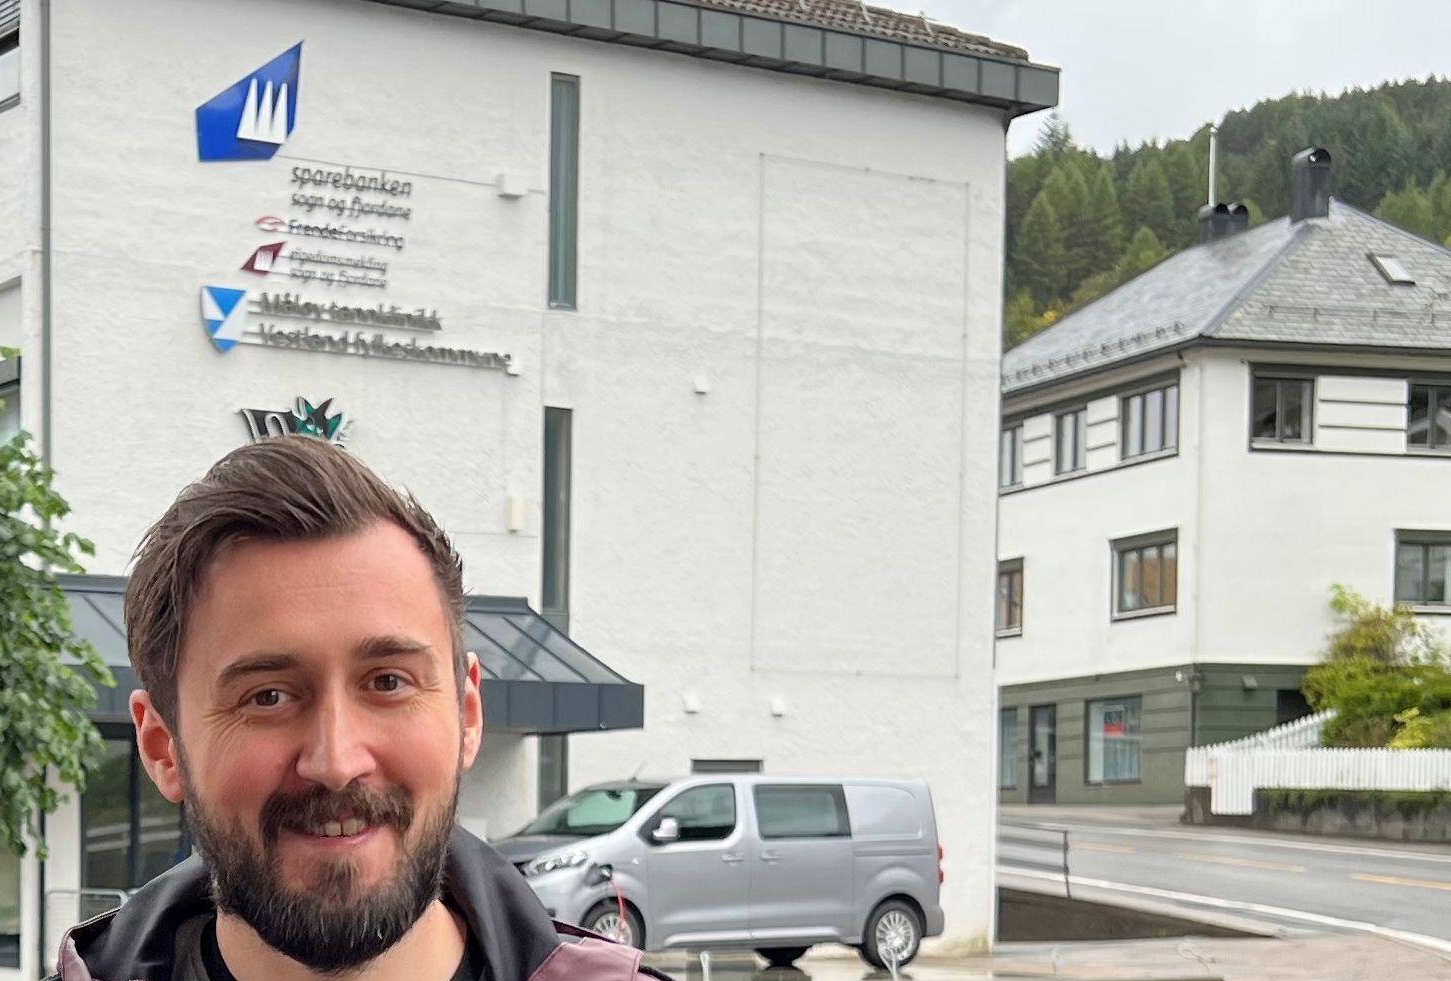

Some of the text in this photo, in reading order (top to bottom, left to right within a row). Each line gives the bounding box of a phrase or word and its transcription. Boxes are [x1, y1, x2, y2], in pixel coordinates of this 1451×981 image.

[291, 166, 411, 198] sparebanken
[291, 193, 324, 212] sogn
[327, 198, 345, 216] og
